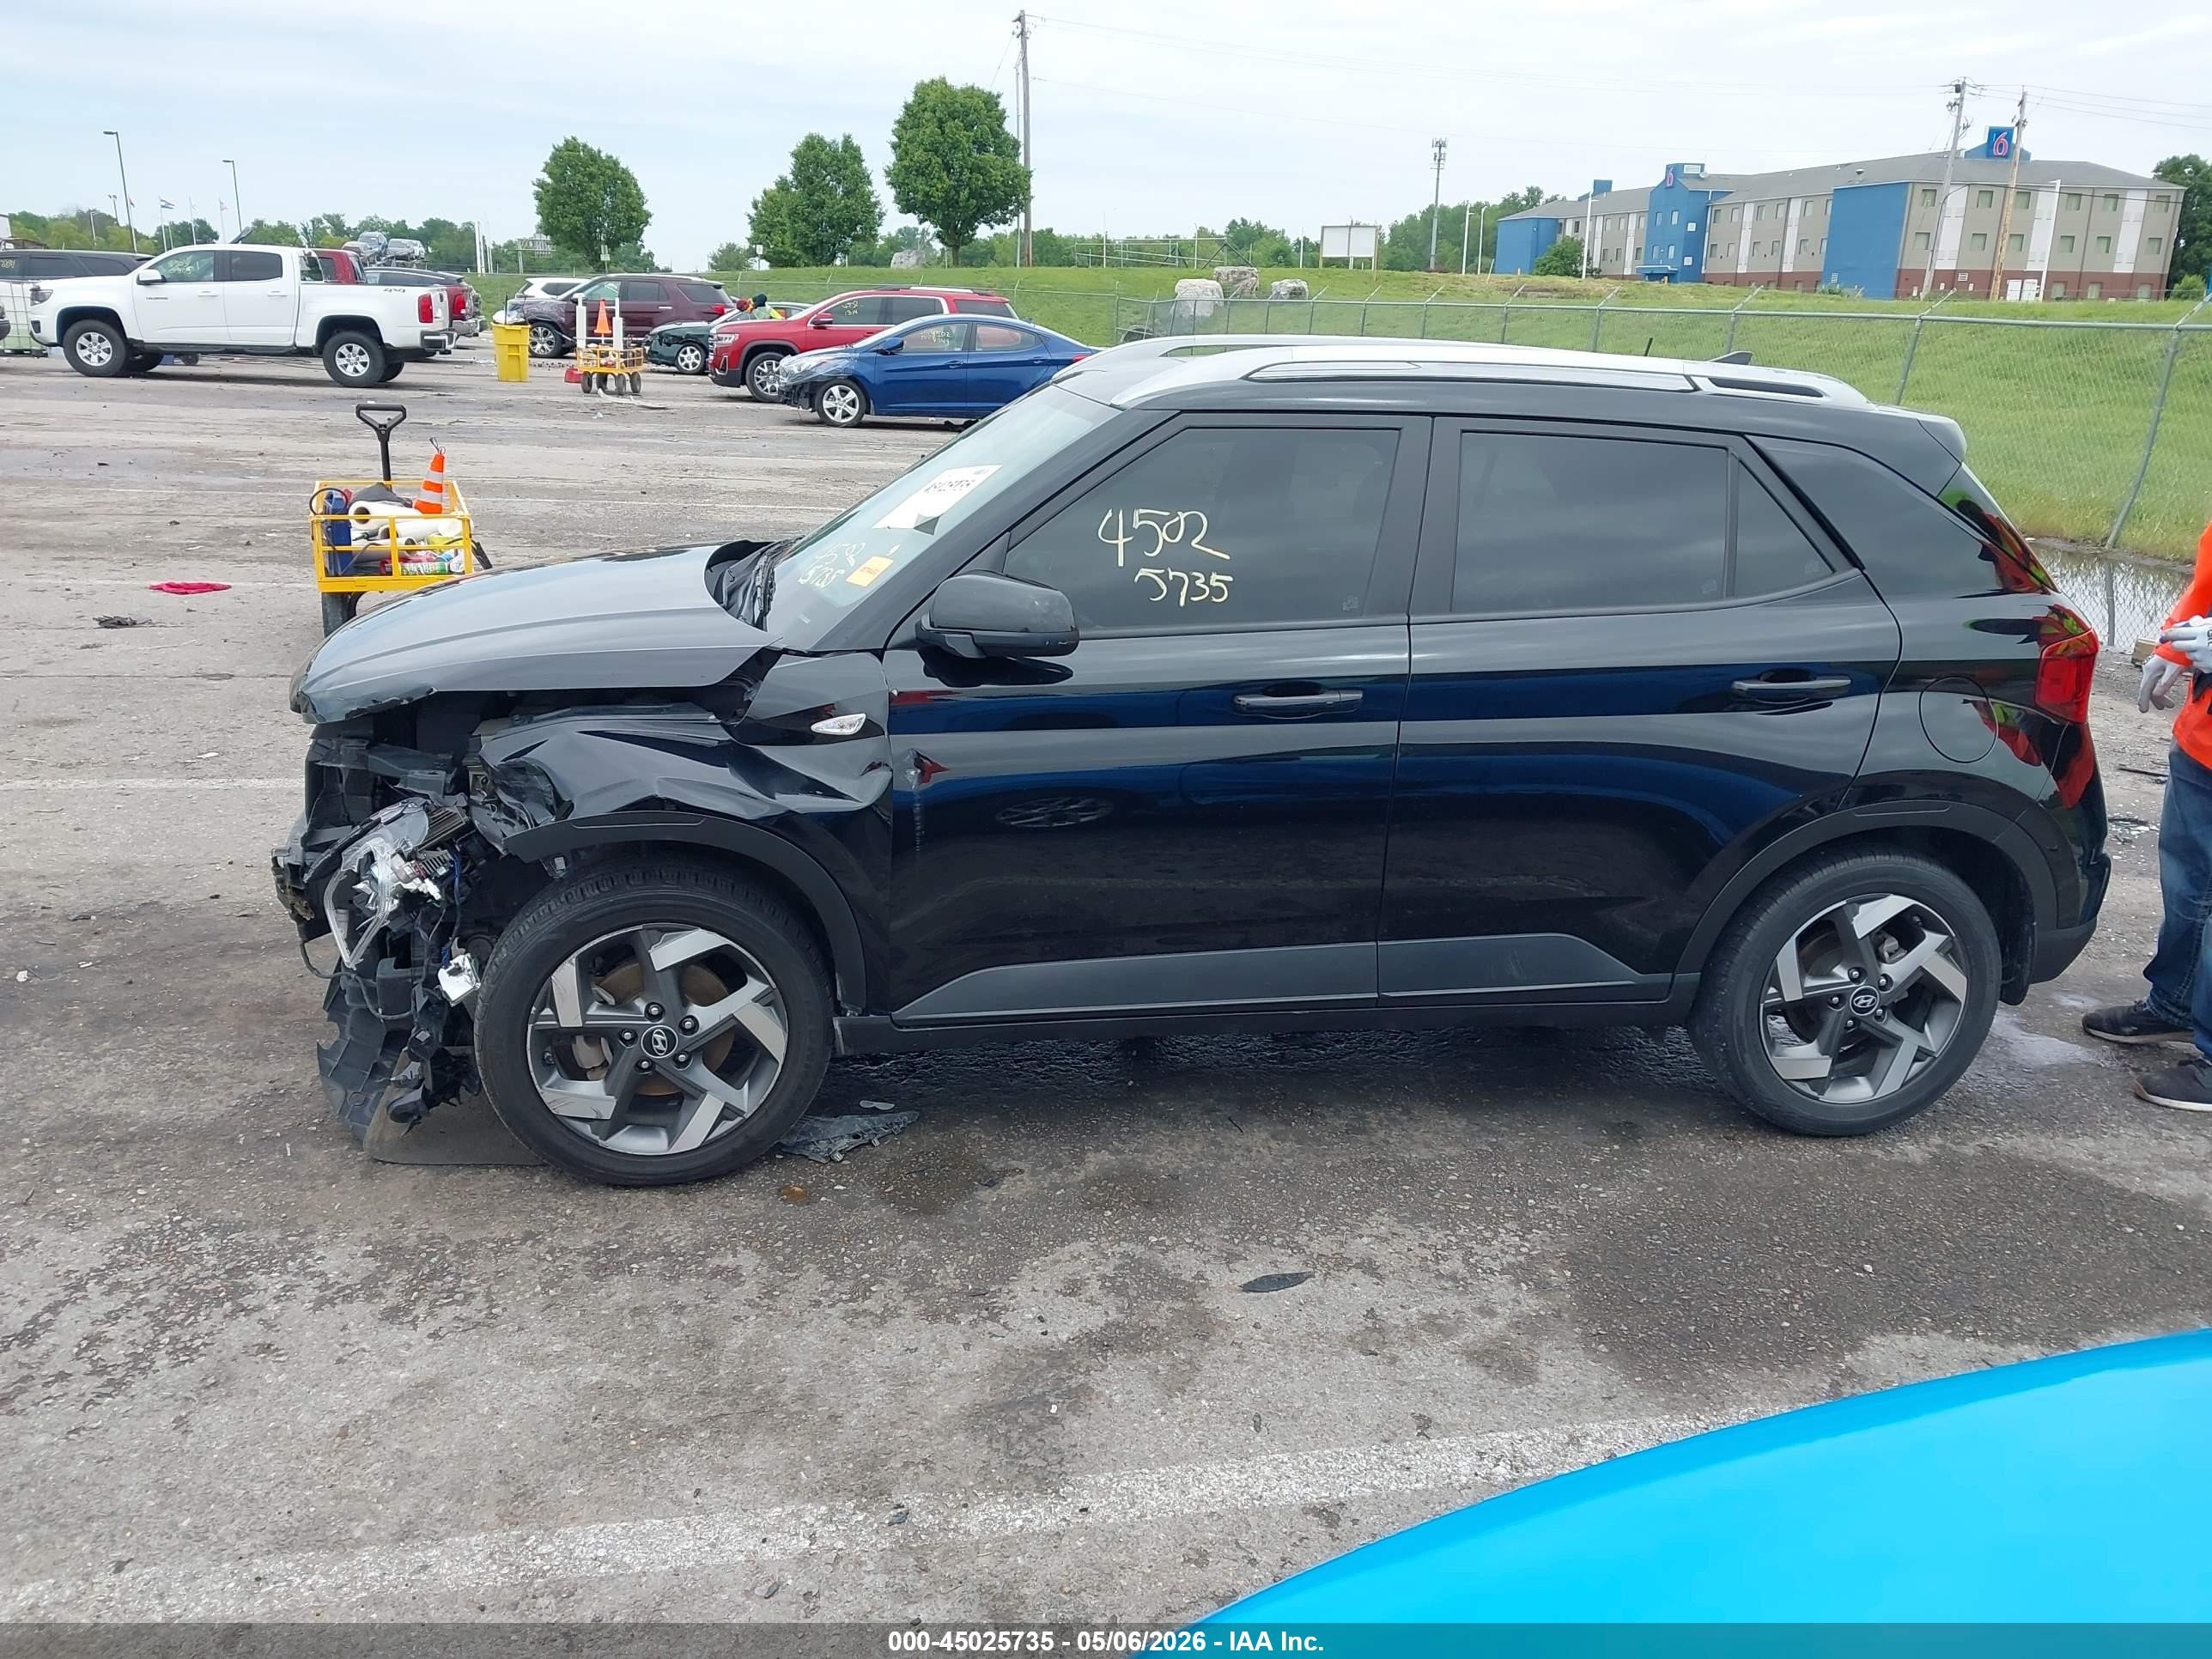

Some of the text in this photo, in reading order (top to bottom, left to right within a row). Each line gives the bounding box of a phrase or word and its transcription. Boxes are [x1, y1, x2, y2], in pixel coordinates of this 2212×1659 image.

[1993, 131, 2008, 156] 6
[1098, 508, 1231, 567] 4502
[1133, 567, 1234, 607] 5735
